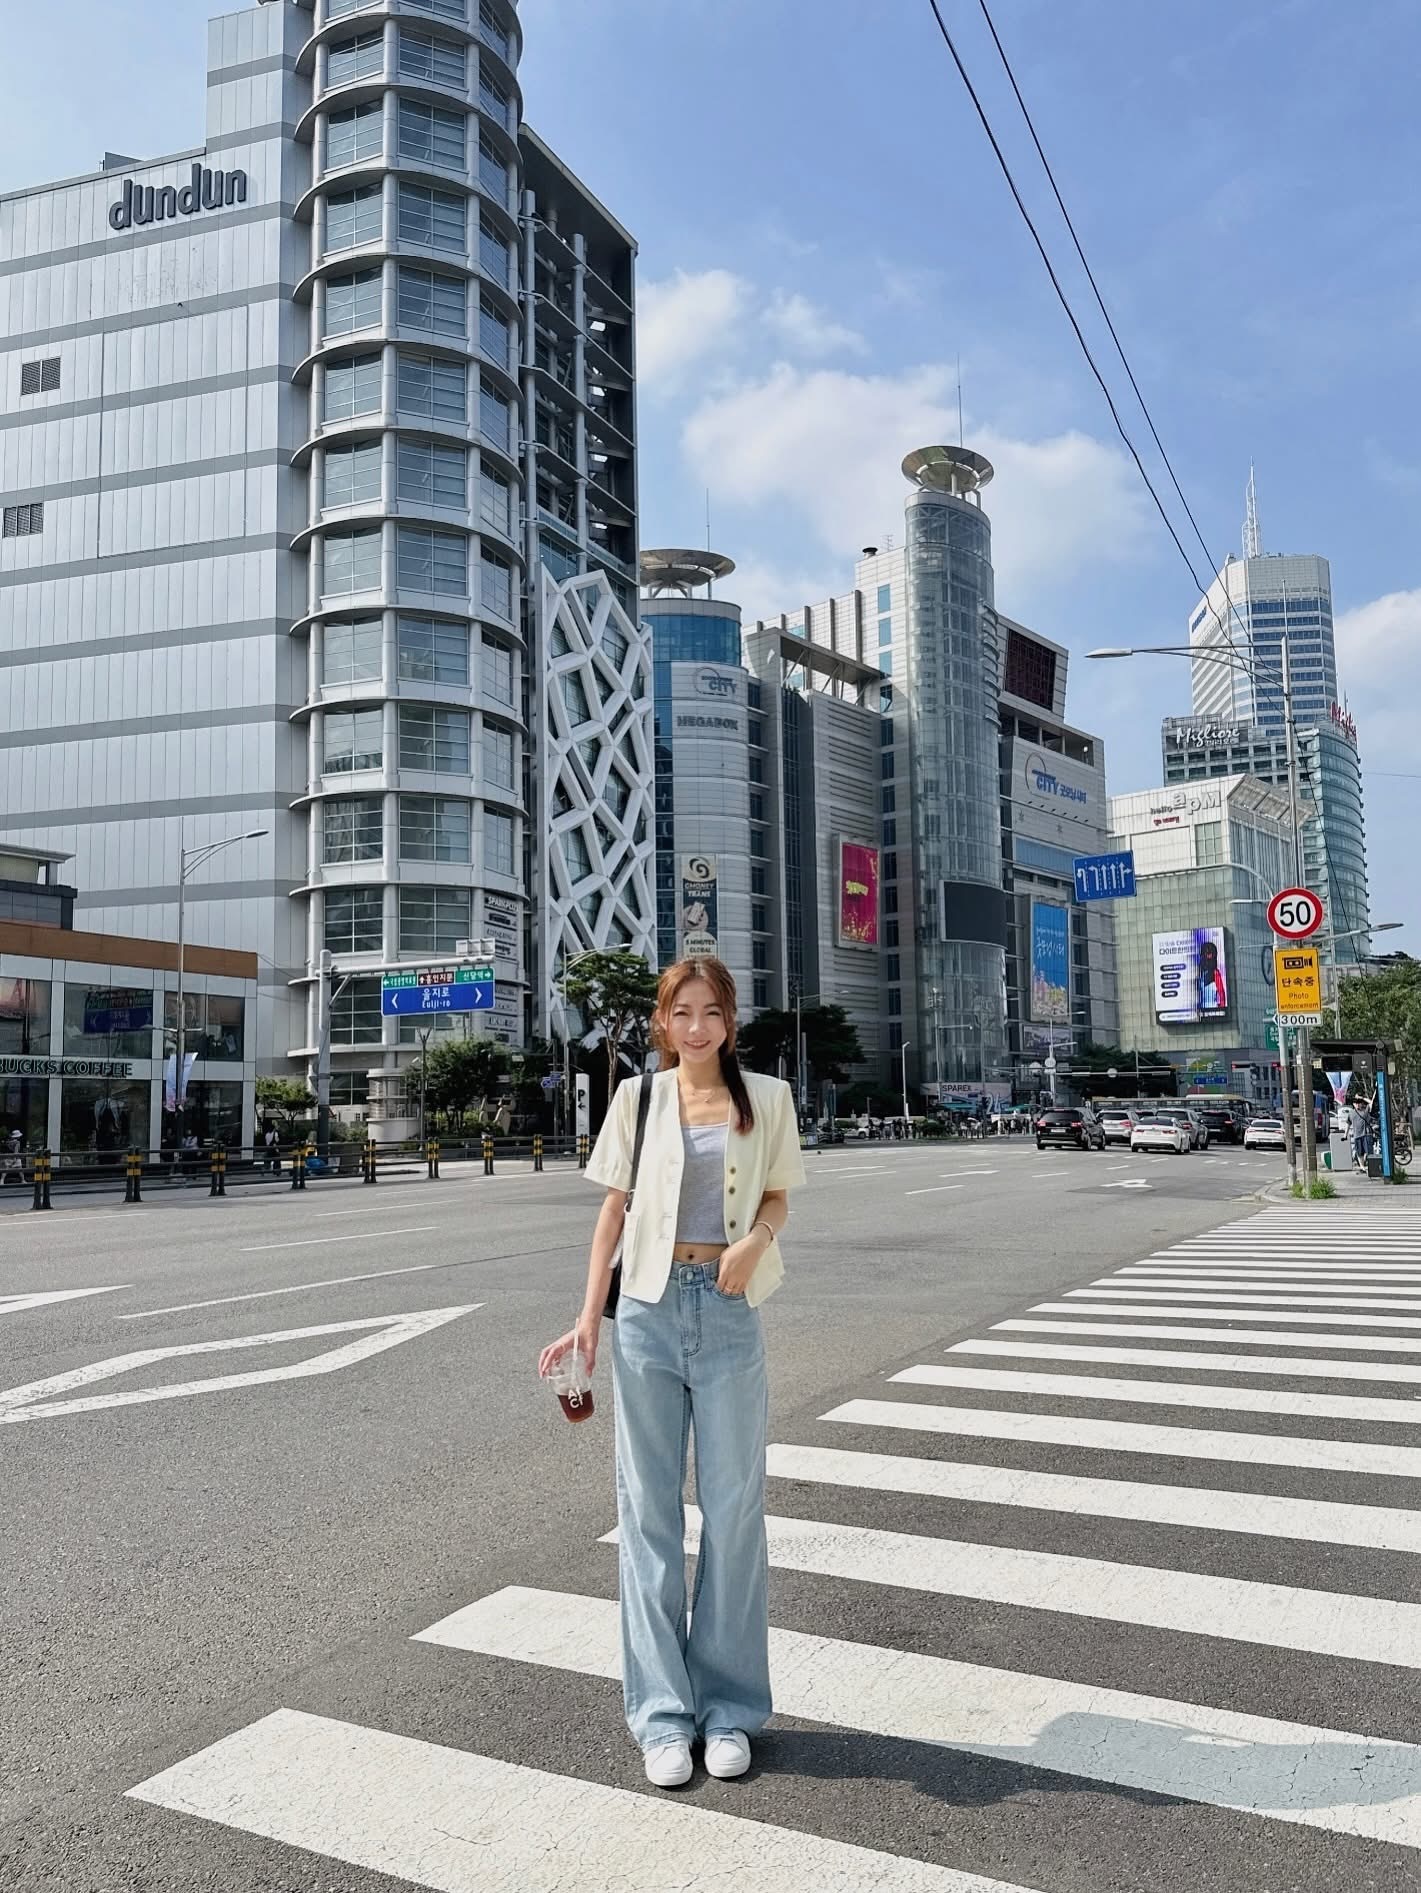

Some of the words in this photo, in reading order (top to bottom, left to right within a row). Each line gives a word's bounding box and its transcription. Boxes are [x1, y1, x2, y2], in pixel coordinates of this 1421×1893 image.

[109, 162, 247, 230] dundun
[677, 715, 738, 730] MEGABOX
[1176, 724, 1240, 748] Migliore
[1280, 901, 1311, 927] 50
[1281, 976, 1315, 988] 단속중
[422, 987, 450, 1001] 을지로
[1288, 992, 1309, 1000] Photo
[1280, 1002, 1319, 1010] enforcement
[1281, 1014, 1318, 1025] 300m
[62, 1060, 133, 1078] COFFEE
[577, 1089, 586, 1102] P
